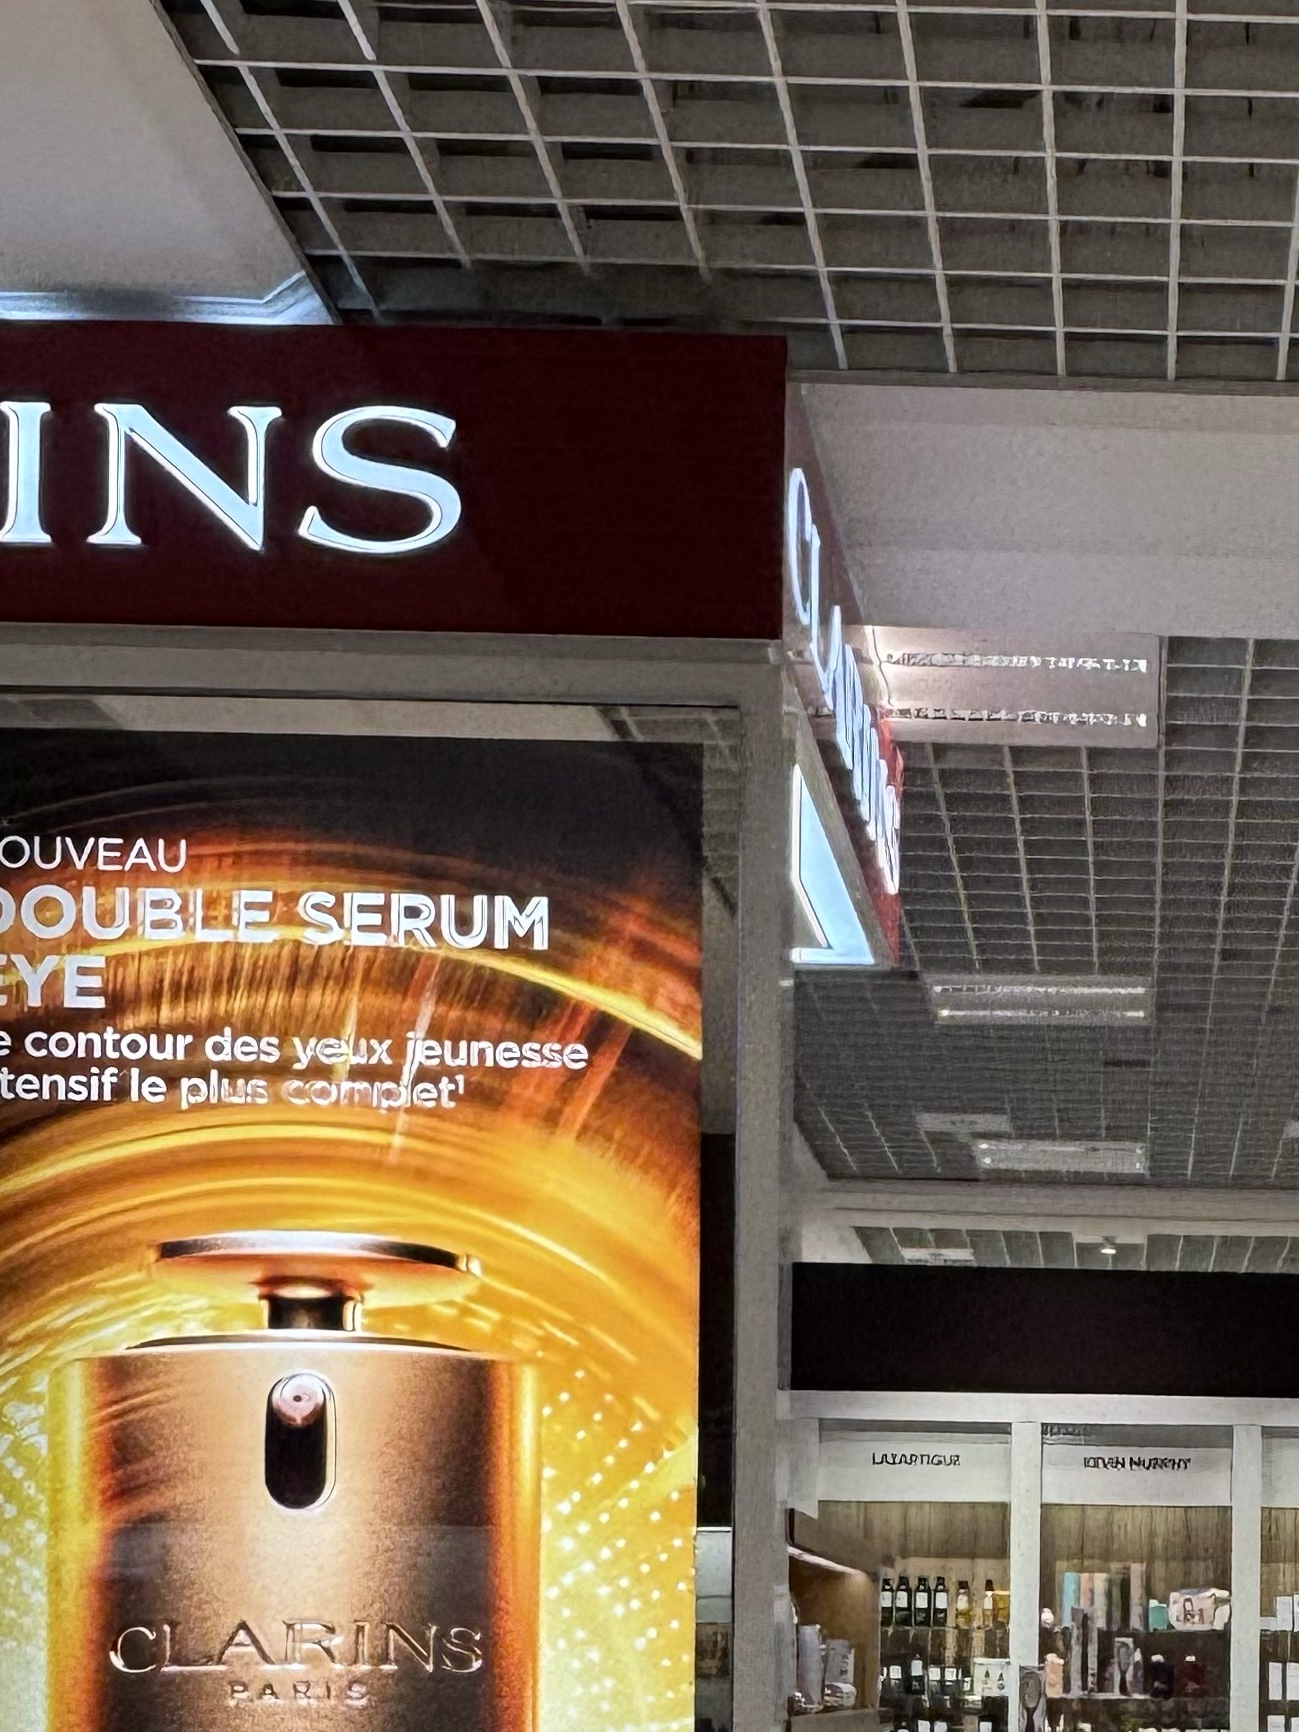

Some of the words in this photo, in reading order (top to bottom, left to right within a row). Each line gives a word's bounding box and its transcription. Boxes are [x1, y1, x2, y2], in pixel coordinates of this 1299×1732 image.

[0, 401, 462, 553] INS
[0, 836, 187, 873] OUVEAU
[296, 891, 549, 950] SERUM
[0, 954, 106, 1009] YE
[24, 1026, 193, 1061] contour
[205, 1026, 280, 1063] des
[292, 1035, 393, 1070] yeux
[404, 1031, 588, 1074] jeunesse
[131, 1067, 167, 1102] le
[181, 1069, 269, 1110] plus
[109, 1619, 483, 1674] CLARINS
[227, 1680, 369, 1705] PARIS
